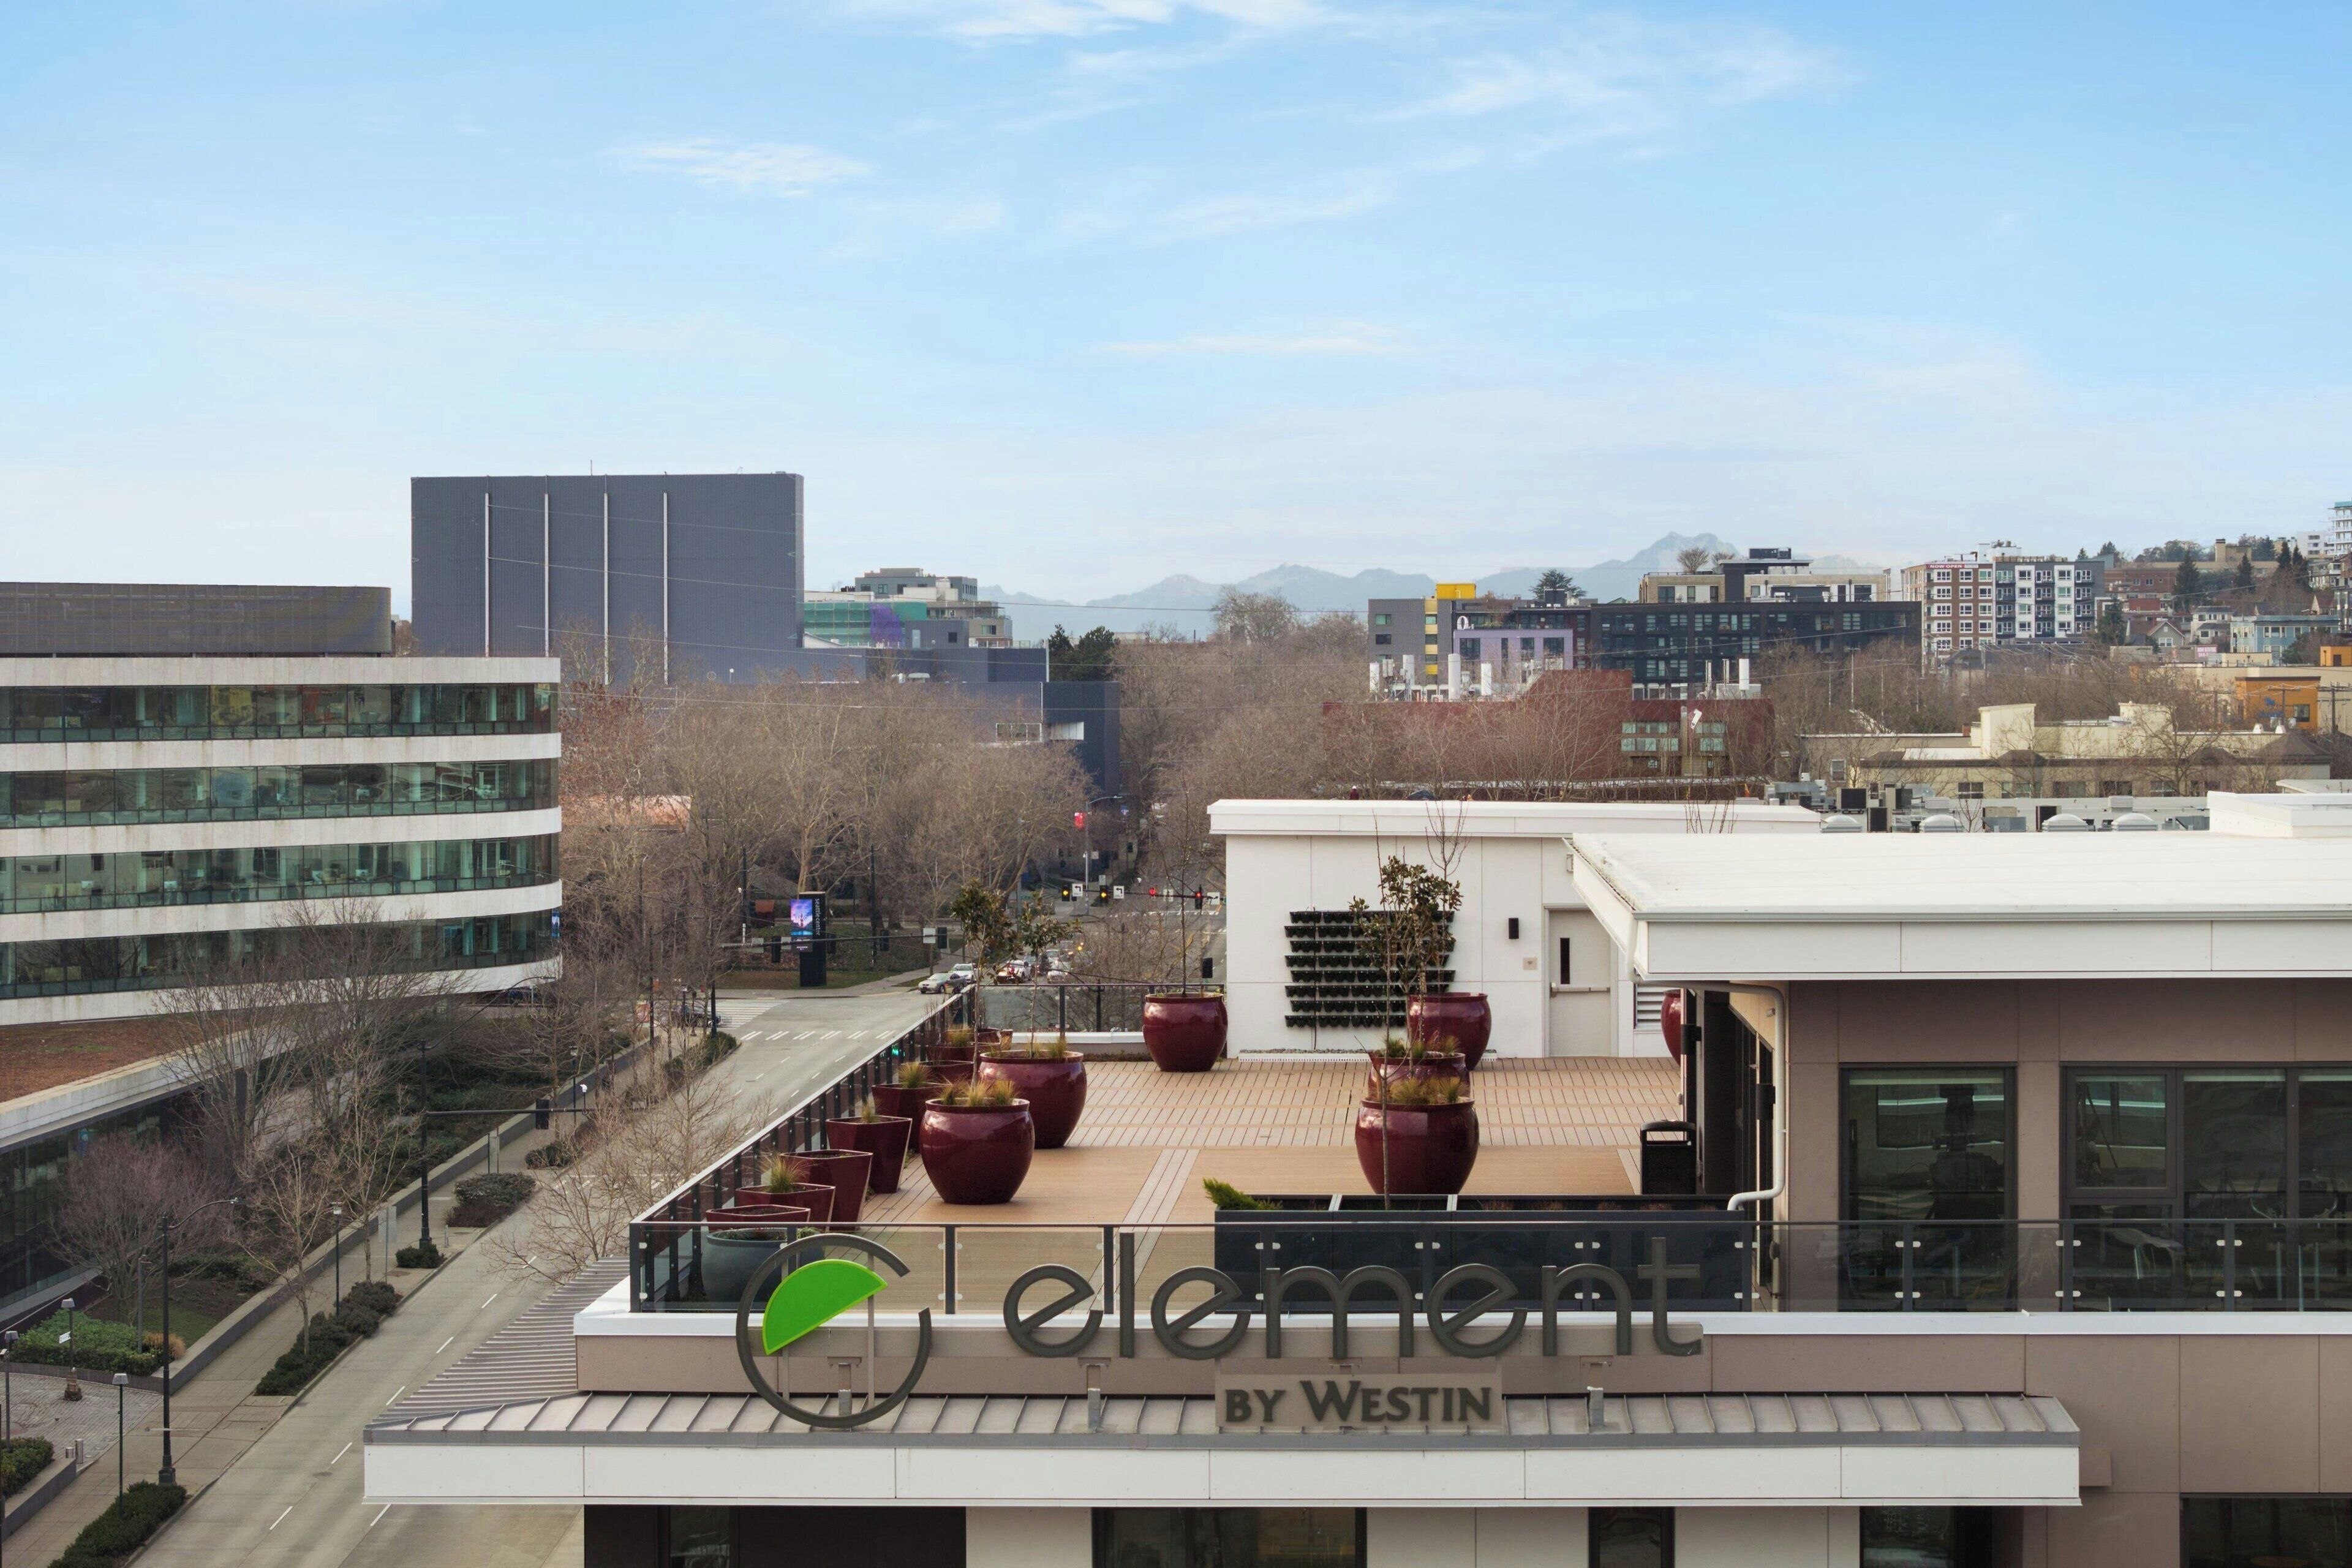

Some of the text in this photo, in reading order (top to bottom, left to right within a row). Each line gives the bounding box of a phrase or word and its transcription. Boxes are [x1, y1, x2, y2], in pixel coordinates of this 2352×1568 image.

[1003, 1232, 1702, 1358] element
[1226, 1380, 1491, 1422] BY WESTIN
